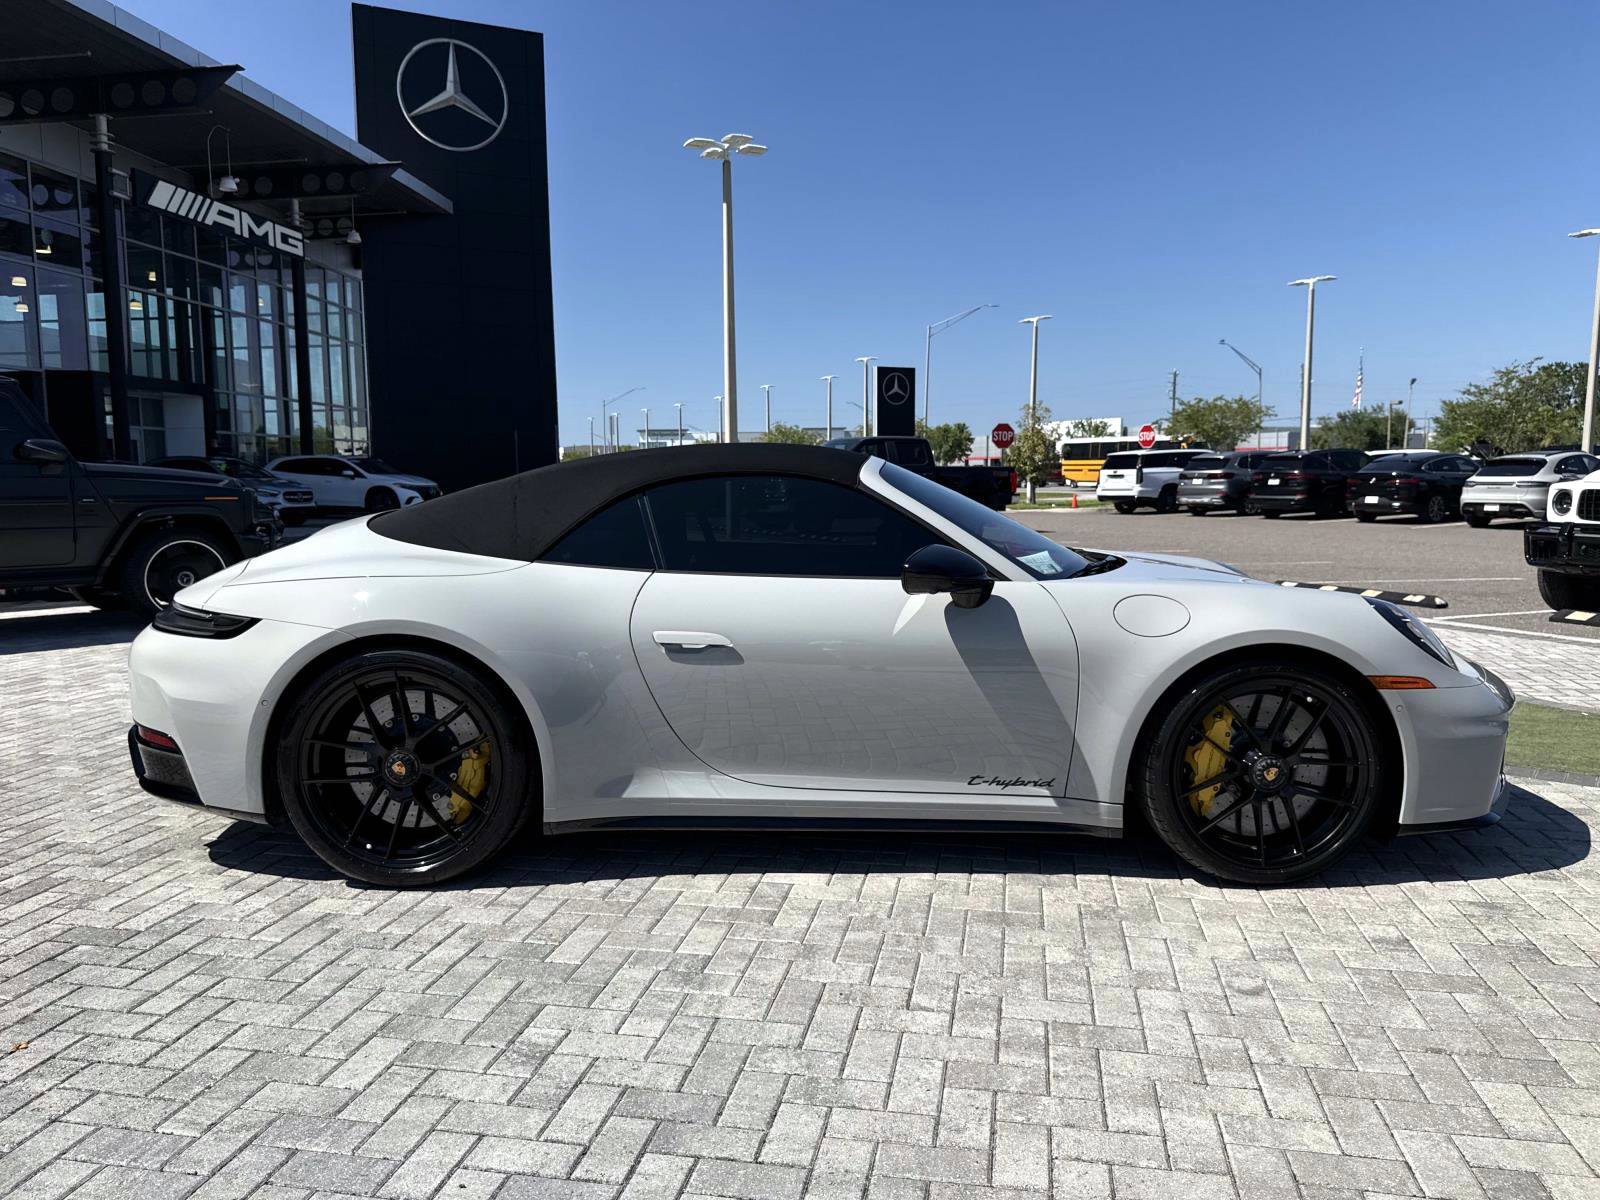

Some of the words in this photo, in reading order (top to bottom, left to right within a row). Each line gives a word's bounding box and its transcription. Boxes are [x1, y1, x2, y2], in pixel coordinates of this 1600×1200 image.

[204, 200, 304, 257] AMG
[993, 430, 1014, 441] STOP
[1139, 431, 1154, 441] STOP
[967, 775, 1056, 790] t-hybrid
